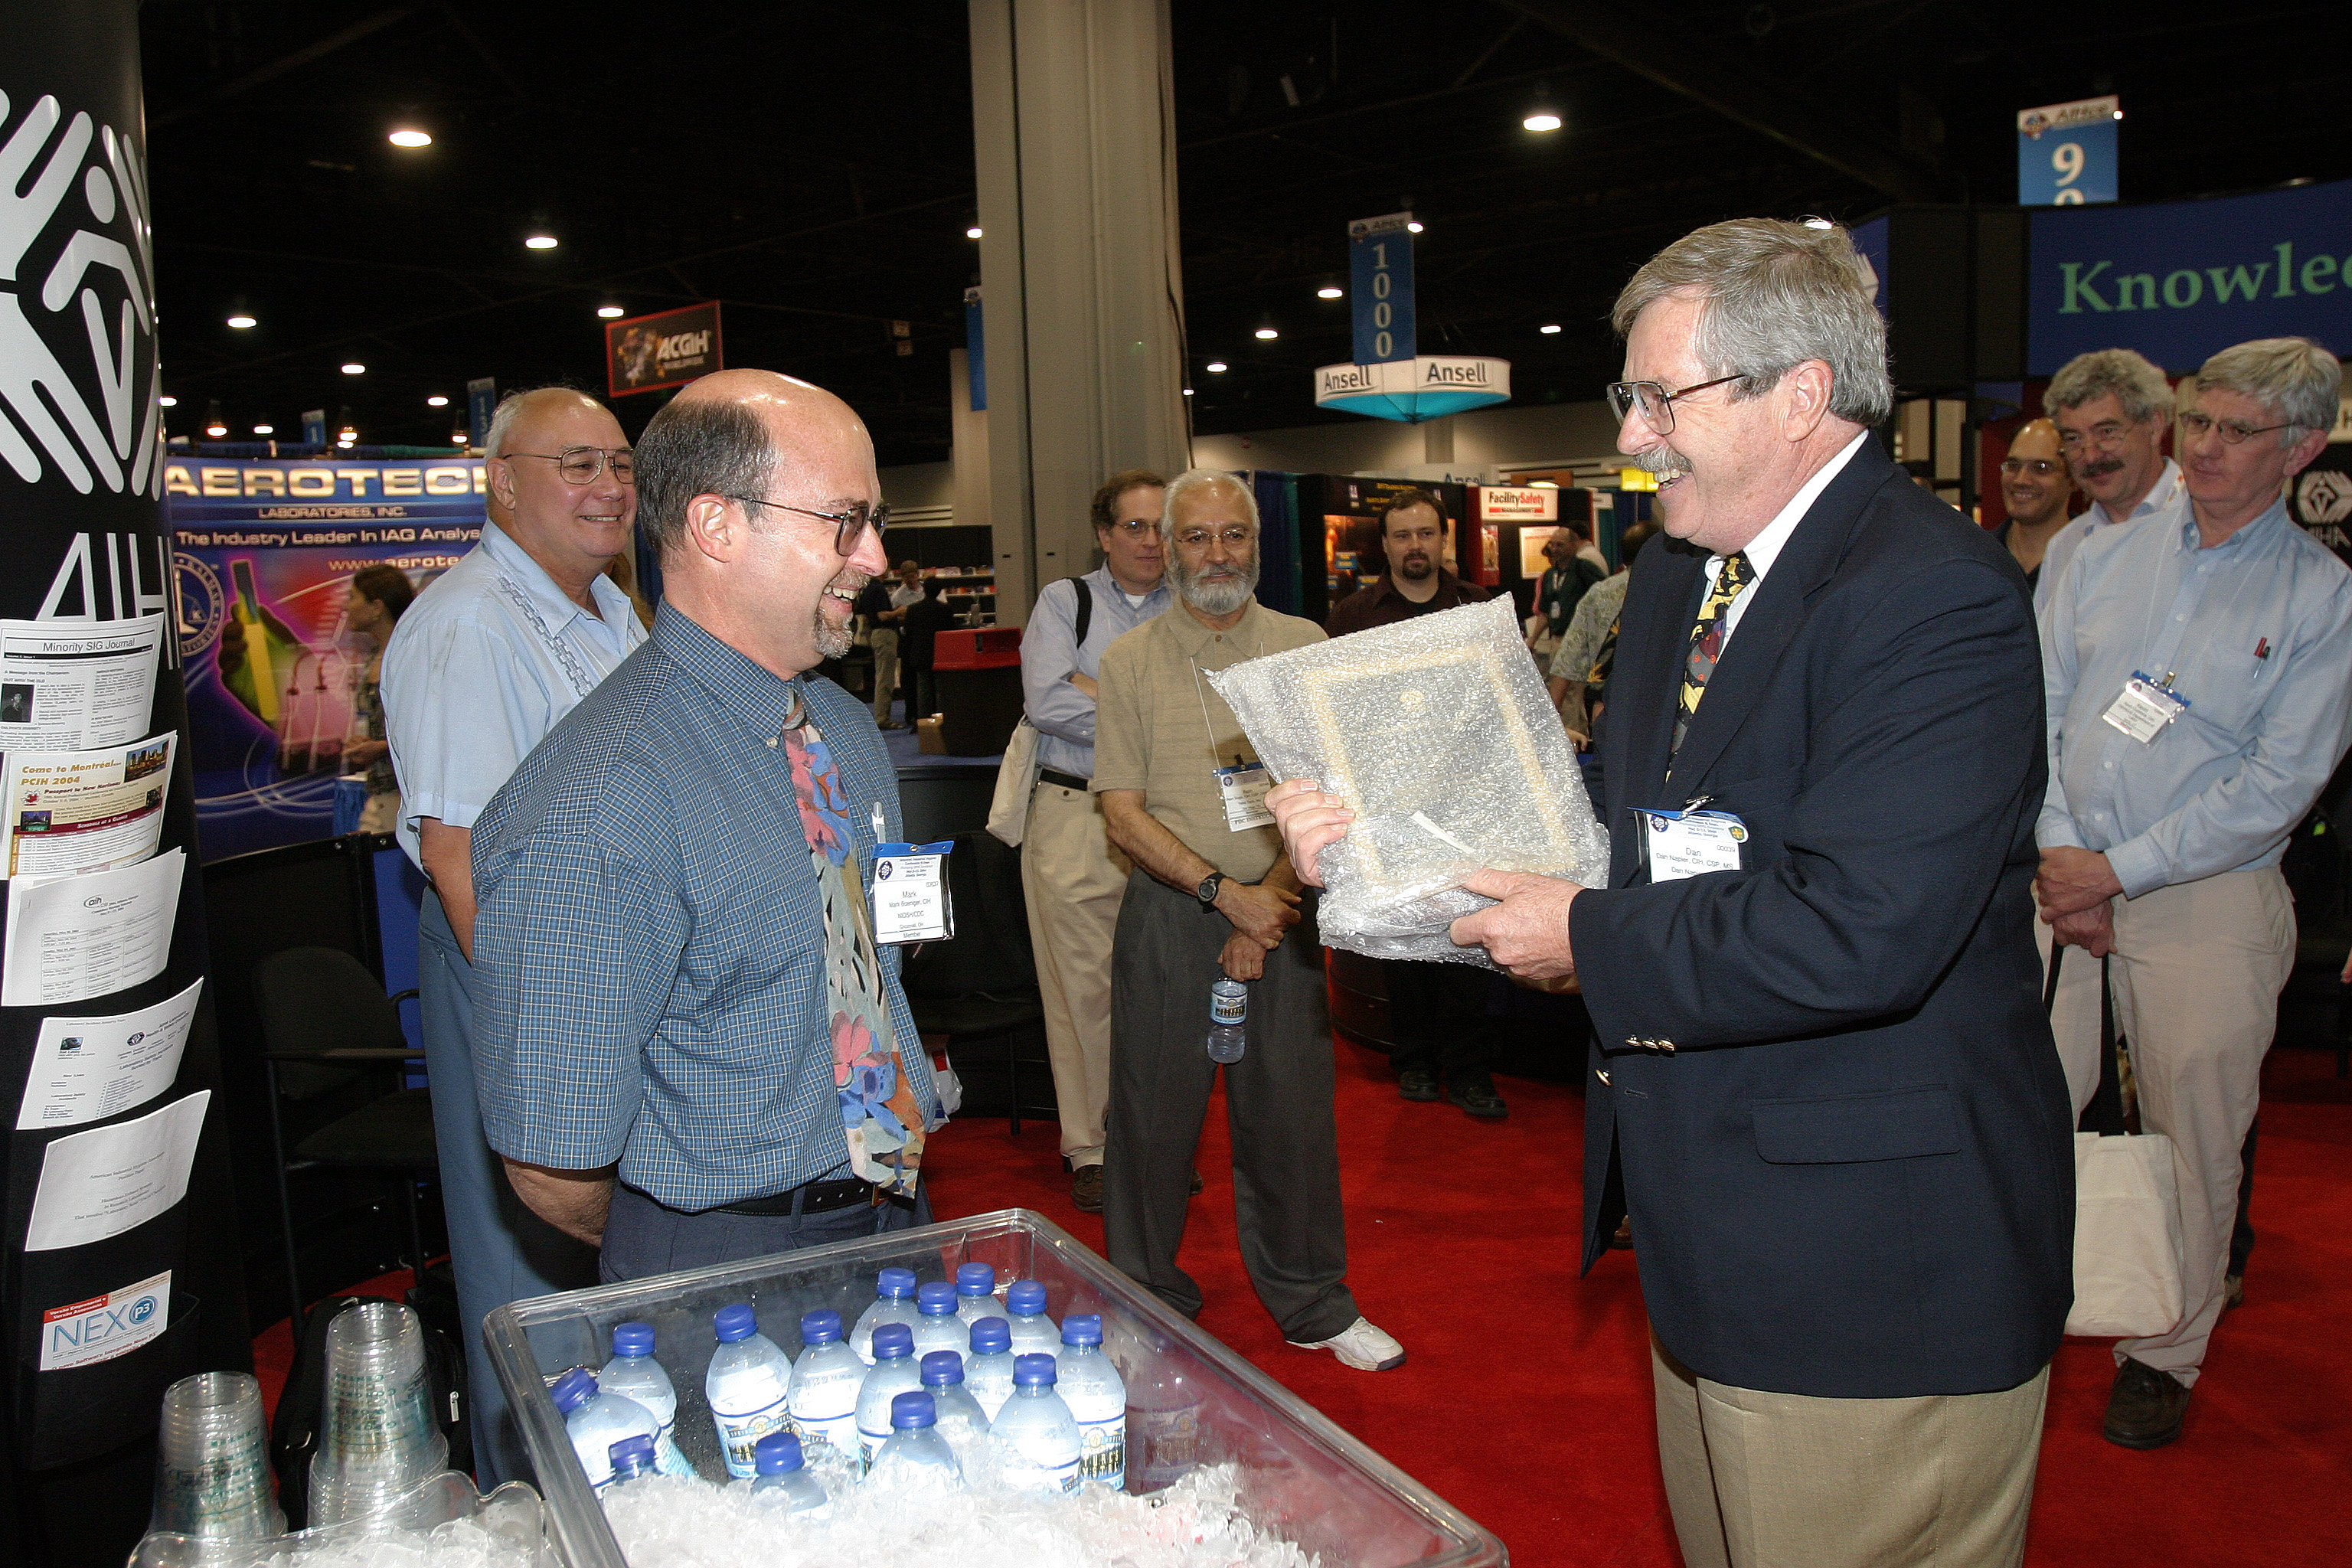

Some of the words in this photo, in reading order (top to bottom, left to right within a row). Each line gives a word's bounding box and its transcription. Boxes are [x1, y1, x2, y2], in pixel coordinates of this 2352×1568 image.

[2058, 241, 2352, 314] Knowle
[1373, 243, 1393, 358] 1000
[656, 329, 710, 361] ACGIH
[1325, 364, 1371, 390] Ansell
[1427, 362, 1487, 382] Ansell
[259, 506, 374, 519] LABORATORIES,
[377, 506, 407, 518] INC.
[176, 531, 210, 546] The
[213, 531, 288, 547] Industry
[292, 531, 357, 544] Leader
[381, 528, 416, 542] IAQ
[35, 532, 181, 670] AIH
[43, 642, 83, 653] Minority
[86, 641, 103, 651] SIG
[106, 638, 136, 649] Journal
[21, 766, 52, 774] Come
[52, 776, 80, 785] 2004
[1686, 848, 1701, 856] Dan
[135, 1302, 151, 1319] P3
